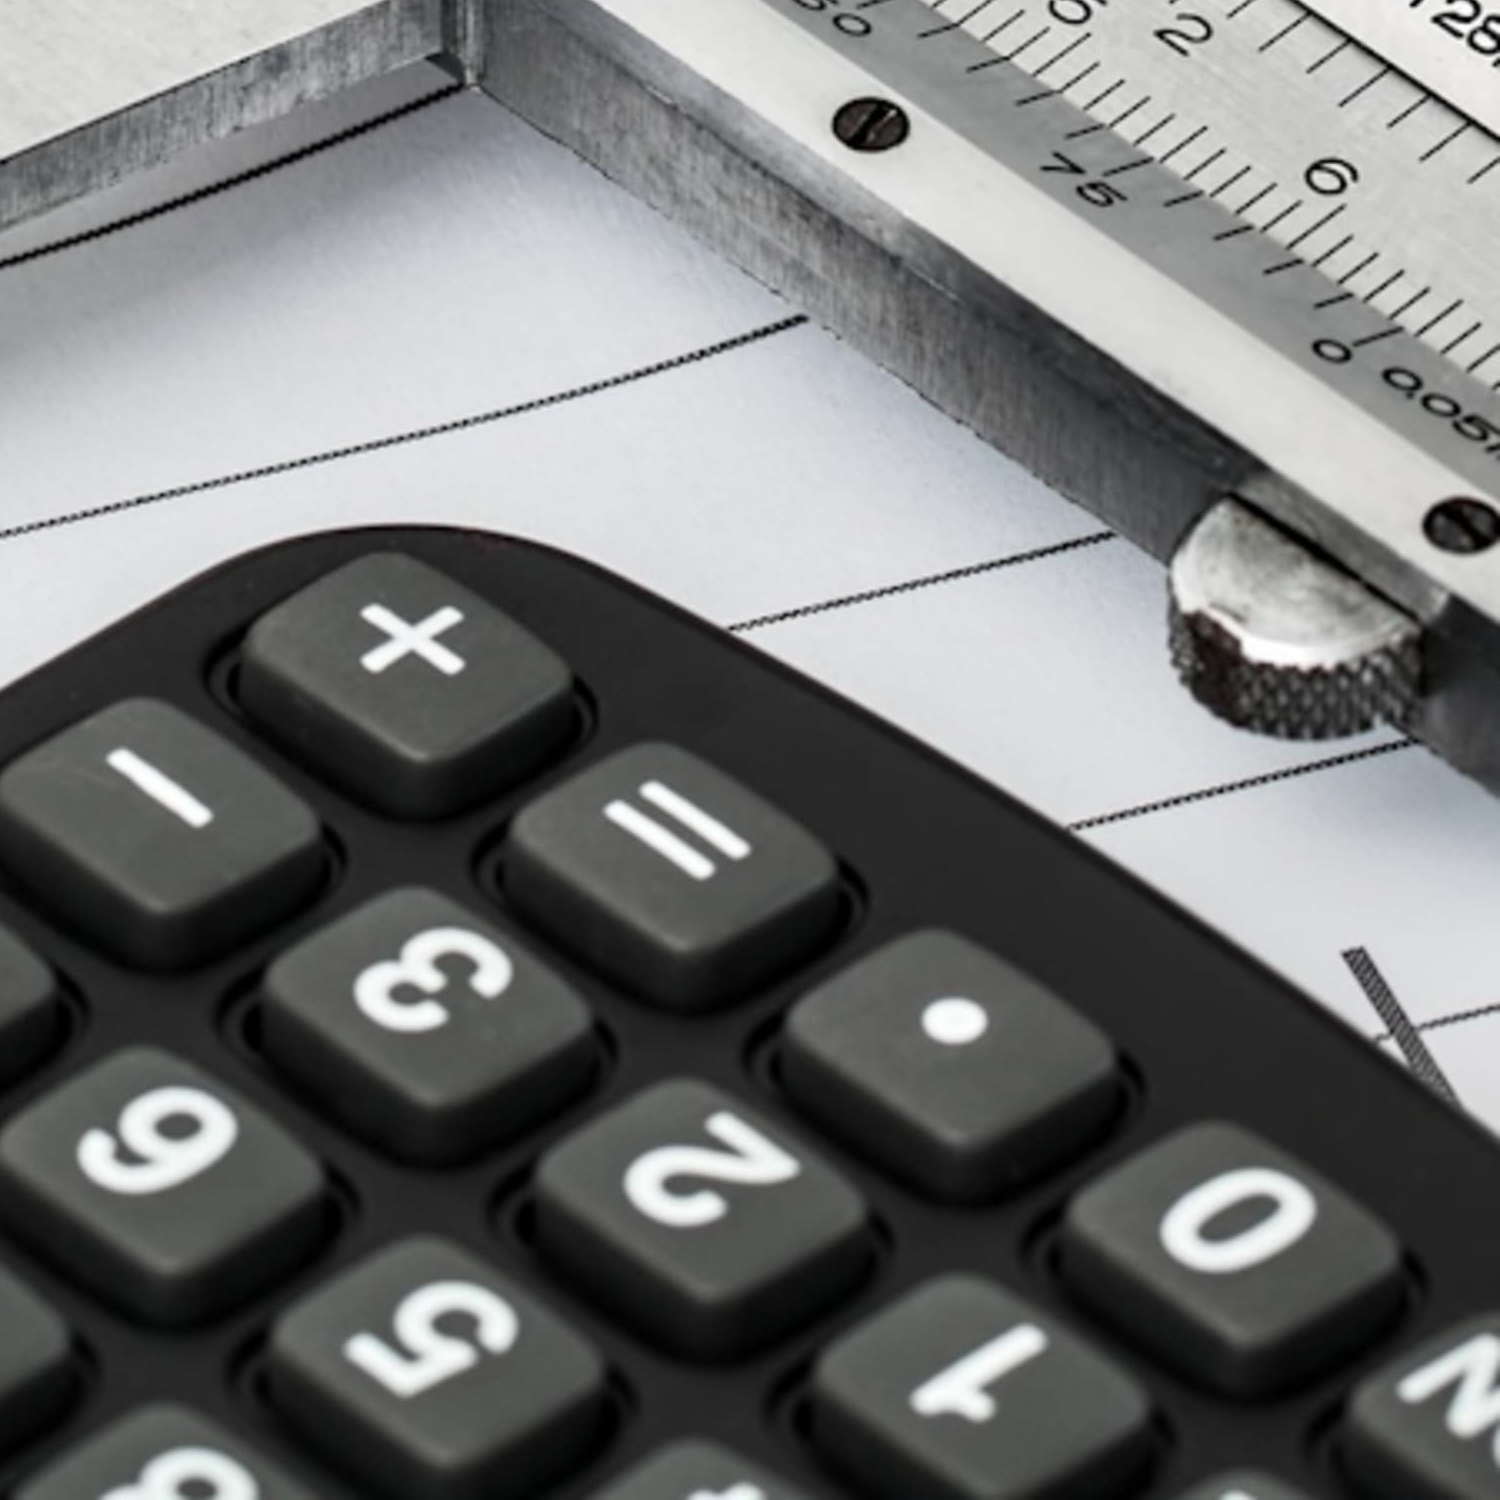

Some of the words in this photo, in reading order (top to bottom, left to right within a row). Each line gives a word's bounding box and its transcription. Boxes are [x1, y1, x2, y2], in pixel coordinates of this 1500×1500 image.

[1154, 15, 1216, 57] 2
[1039, 152, 1130, 212] 75
[1304, 156, 1359, 196] 6
[352, 927, 514, 1033] 3
[622, 1112, 802, 1228] 2
[1158, 1167, 1318, 1273] 0
[343, 1280, 520, 1398] 5
[910, 1322, 1048, 1422] 1
